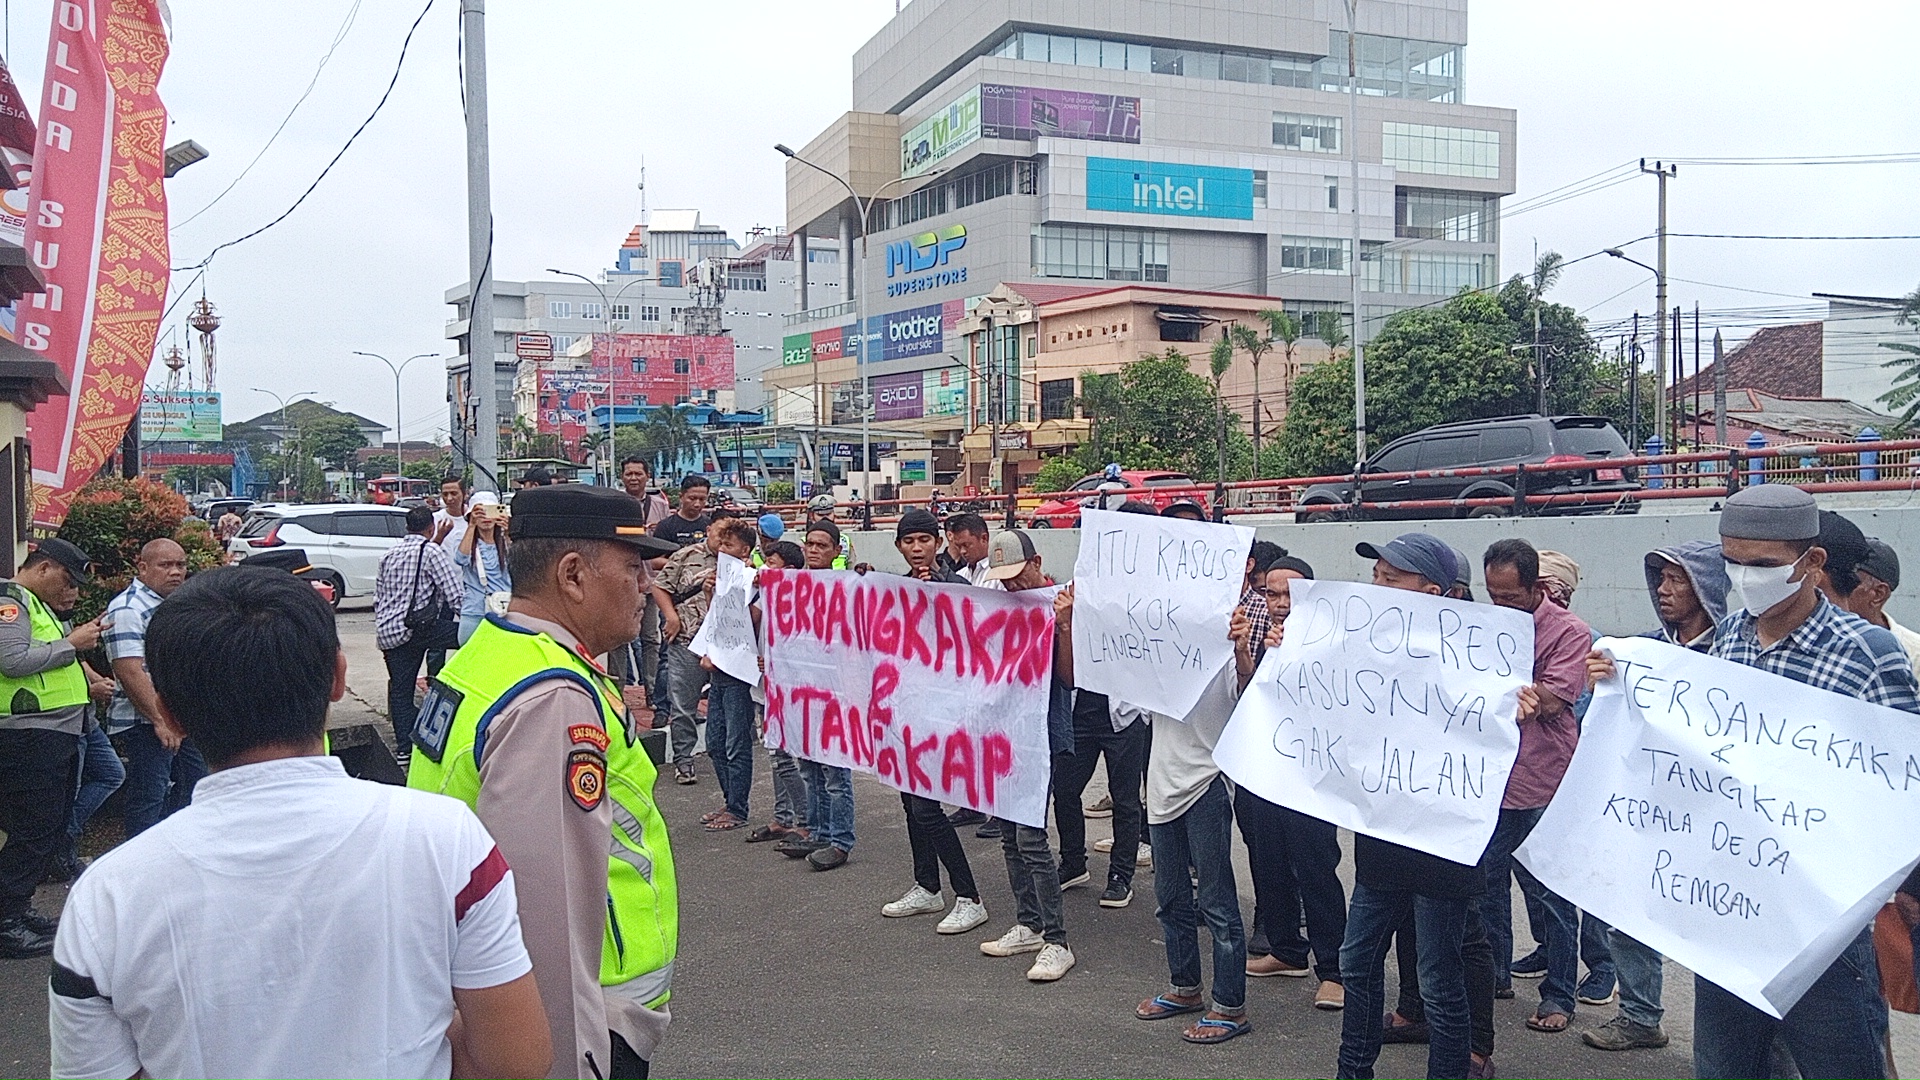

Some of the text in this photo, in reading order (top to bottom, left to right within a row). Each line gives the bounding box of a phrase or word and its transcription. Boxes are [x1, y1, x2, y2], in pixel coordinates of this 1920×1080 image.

[1133, 173, 1204, 210] intel
[886, 224, 967, 278] MDP
[887, 267, 967, 297] SUPERSTORE
[889, 315, 942, 342] brother
[905, 342, 919, 354] your
[919, 338, 933, 350] side
[784, 347, 810, 365] acer
[153, 394, 195, 405] Sukses
[1096, 529, 1237, 582] ITU KASUS
[1127, 593, 1183, 640] KOK
[1301, 595, 1517, 677] DIPOLRES
[1087, 632, 1164, 665] LAMBAT
[1276, 660, 1486, 733] KASUSNYA
[1272, 717, 1485, 799] GAK JALAN
[1642, 748, 1827, 831] TANGKAP
[1602, 793, 1790, 875] KEPALA DESA
[1651, 849, 1761, 920] REMBAN
